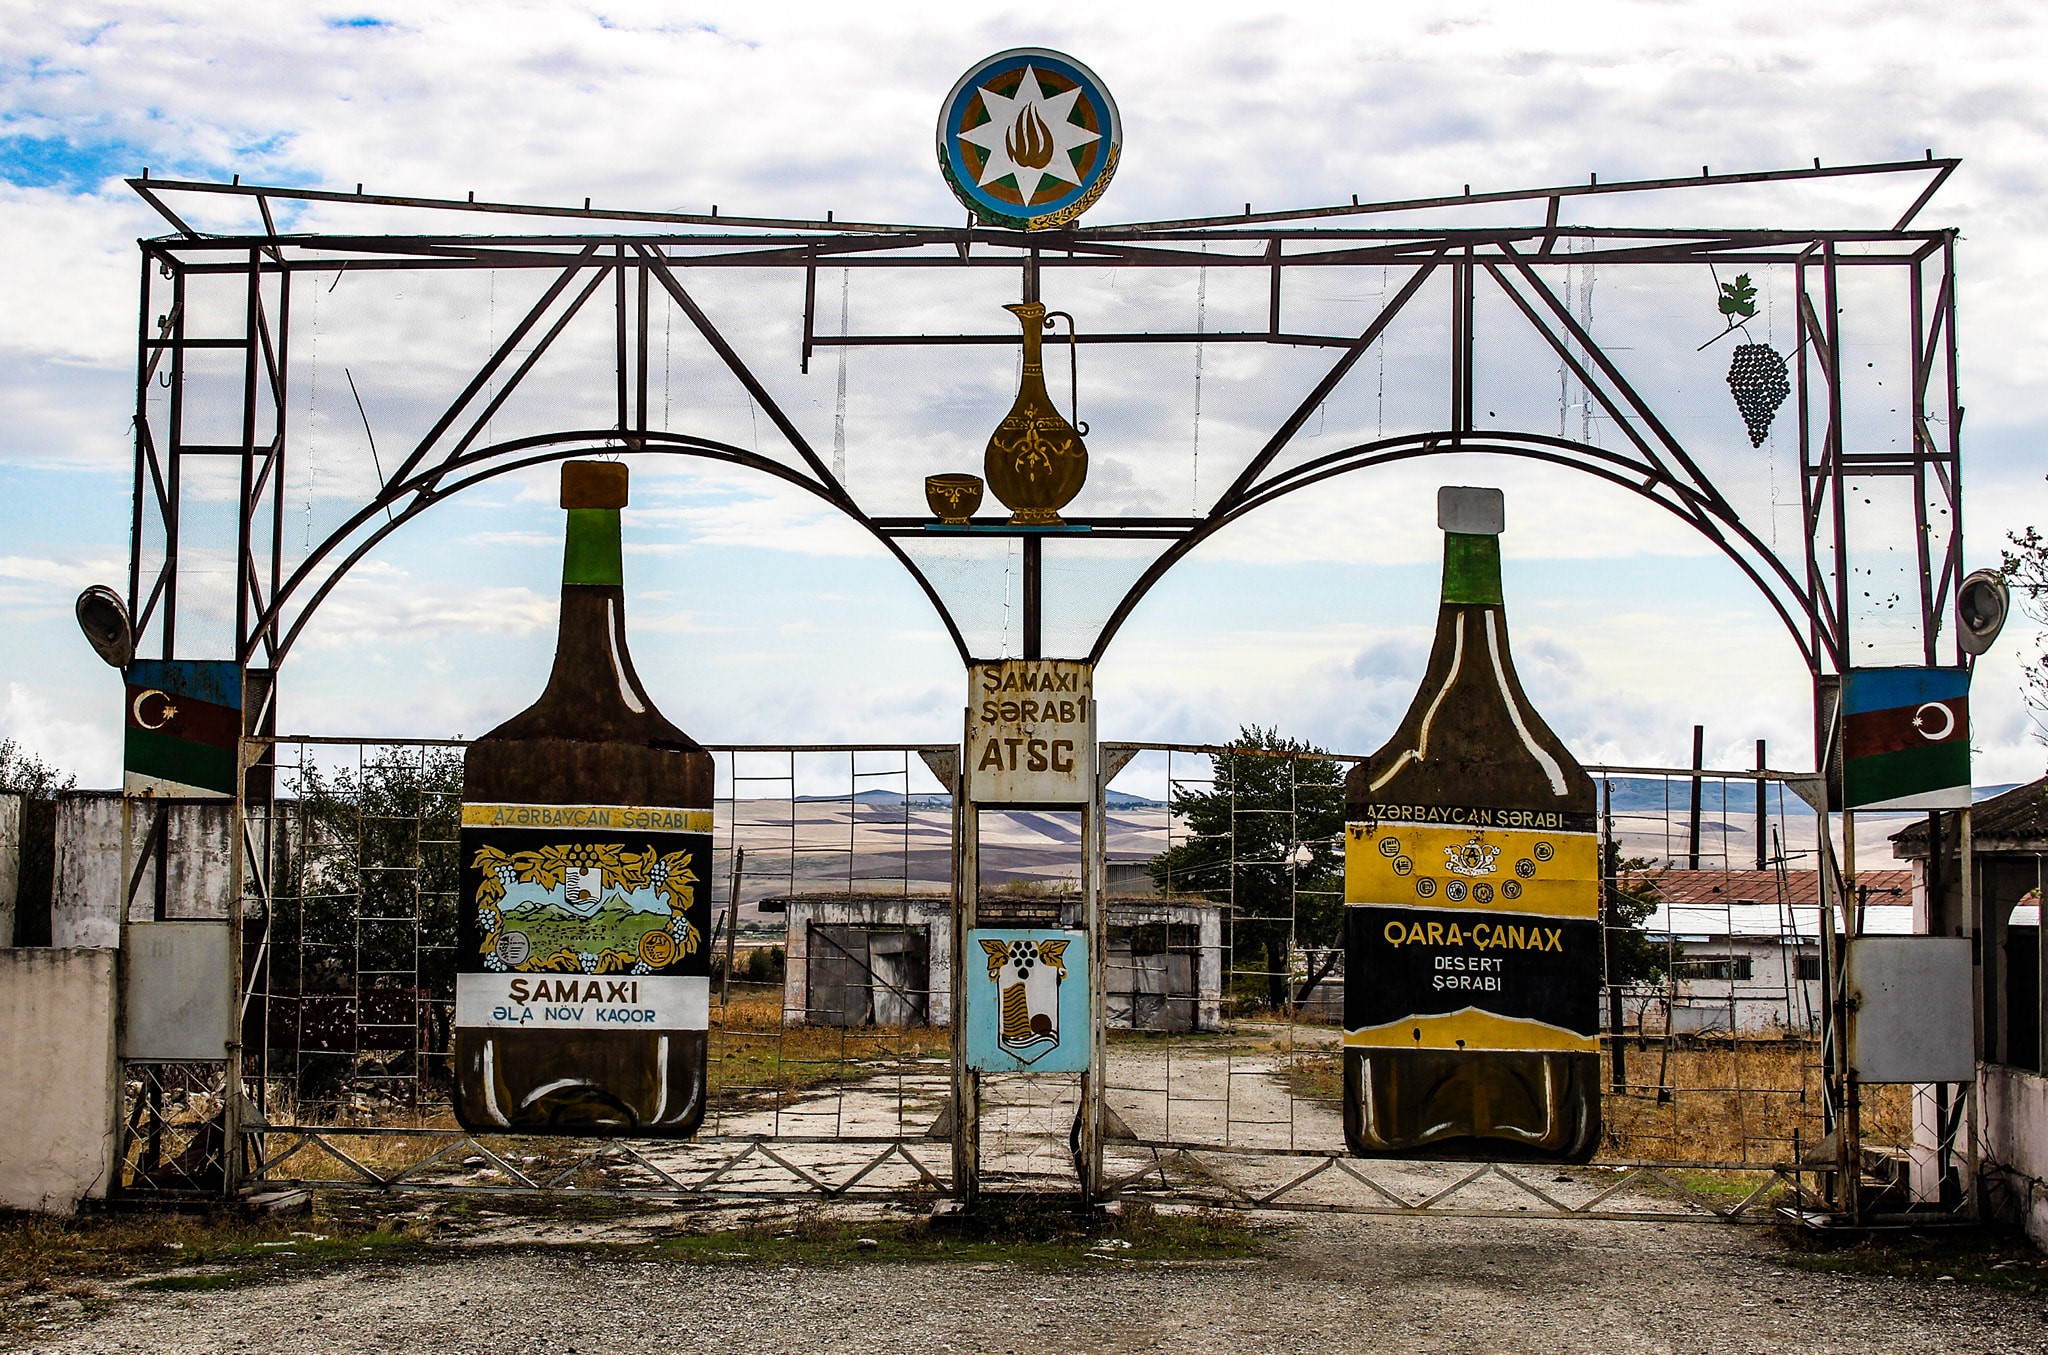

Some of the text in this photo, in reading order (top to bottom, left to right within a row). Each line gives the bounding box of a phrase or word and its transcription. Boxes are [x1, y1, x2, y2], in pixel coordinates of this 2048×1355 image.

[982, 667, 1078, 694] ŞAMAXI
[978, 738, 1074, 773] ATSC
[621, 811, 689, 829] ŞƏRABI
[1367, 804, 1563, 829] AZƏRBAYCAN ŞƏRABI
[1384, 920, 1563, 952] QARA-ÇANAX
[1434, 956, 1503, 971] DESERT
[508, 978, 638, 1006] ŞAMAXI
[1432, 975, 1501, 991] ŞƏRABI
[492, 1004, 656, 1024] ƏLA NÖV KAQOR
